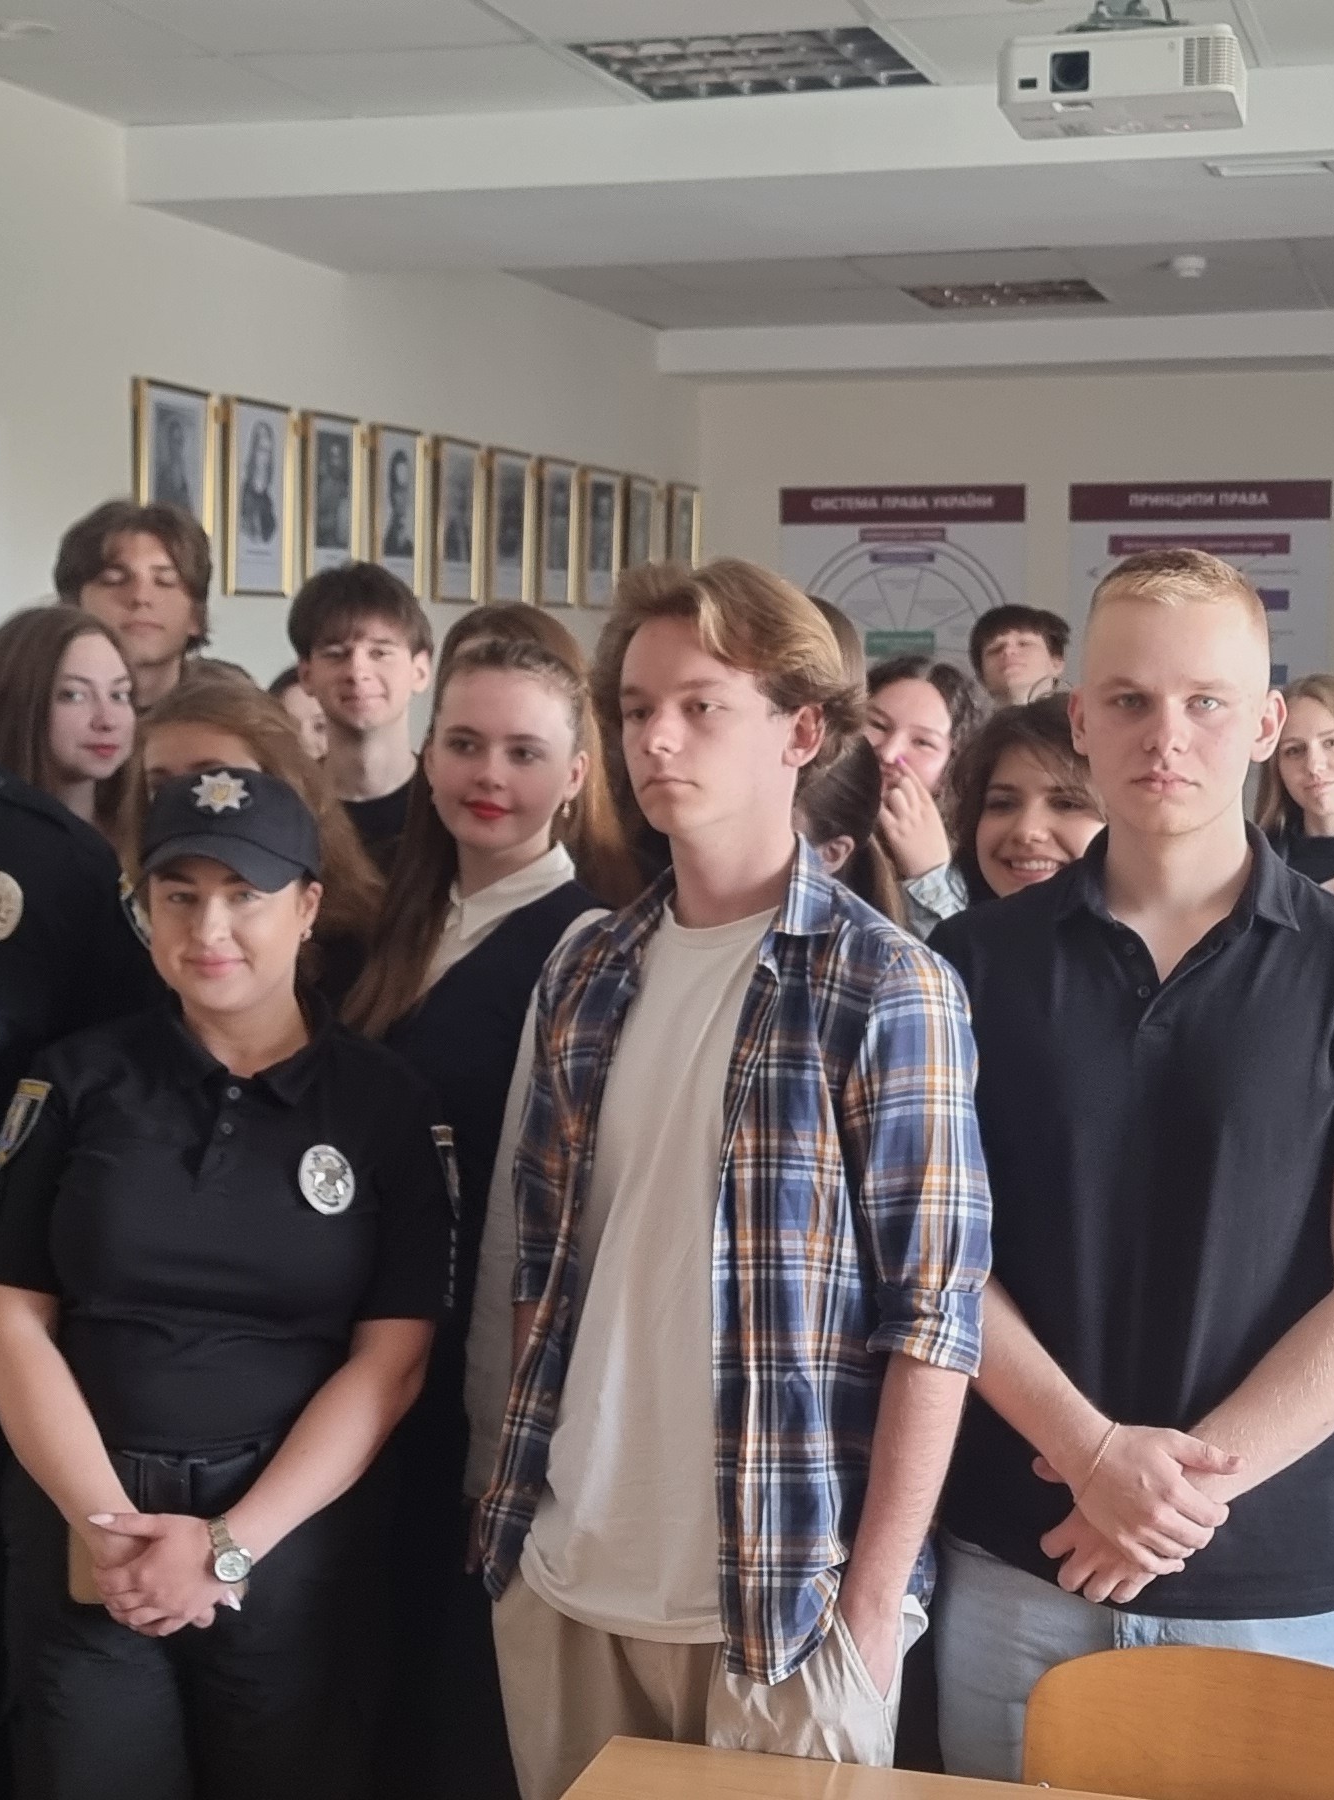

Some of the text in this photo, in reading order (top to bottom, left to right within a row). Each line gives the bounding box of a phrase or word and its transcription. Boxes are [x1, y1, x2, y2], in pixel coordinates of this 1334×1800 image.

[811, 494, 878, 511] СИСТЕМА
[881, 495, 929, 510] ПРАВА
[1128, 491, 1269, 509] ПРИНЦИПИ ПРАВА
